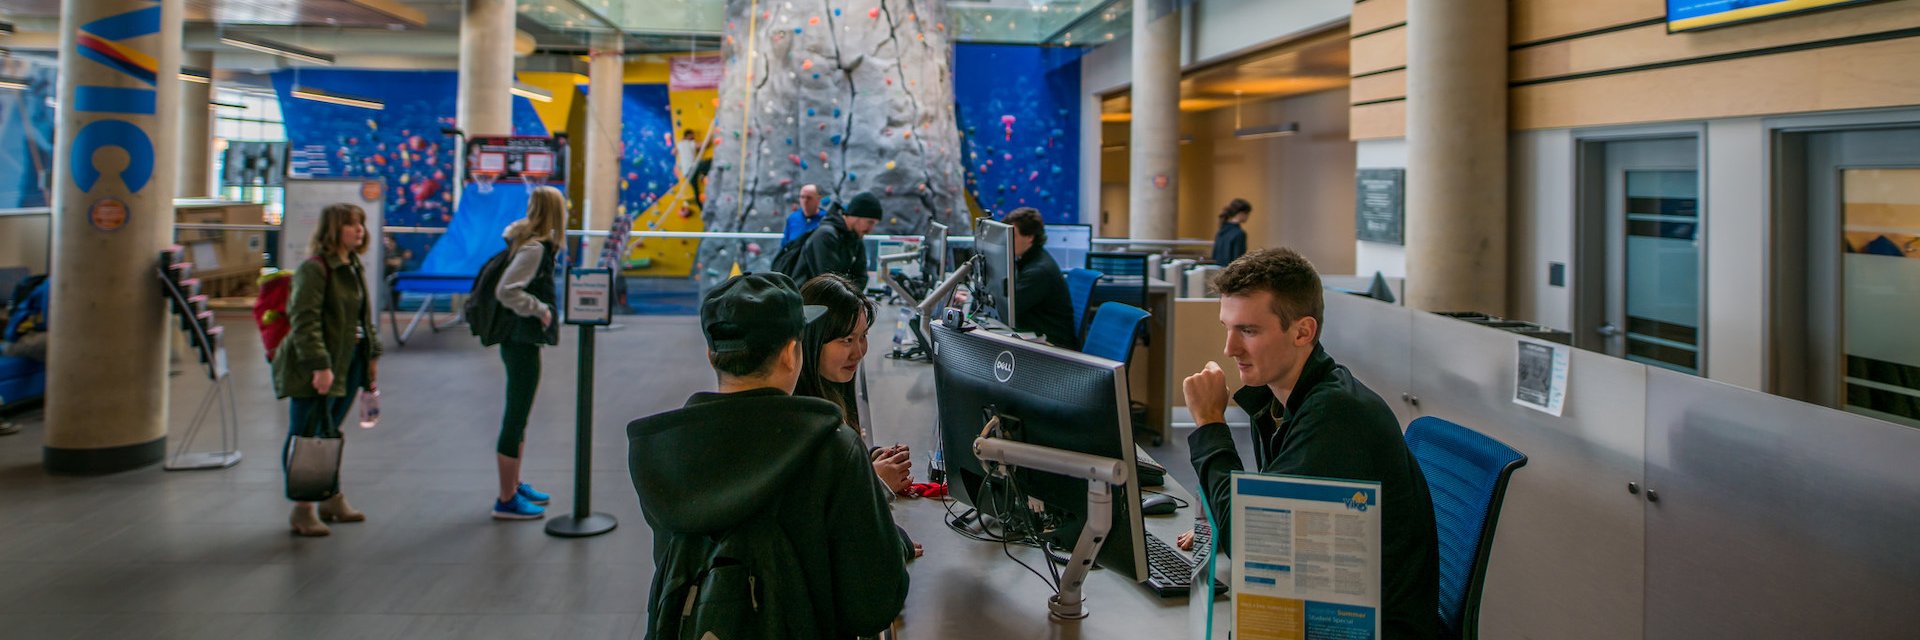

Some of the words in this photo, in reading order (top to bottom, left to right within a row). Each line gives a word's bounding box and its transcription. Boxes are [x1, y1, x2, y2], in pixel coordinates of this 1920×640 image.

[996, 360, 1012, 372] DELL
[1337, 609, 1367, 618] Summer
[1308, 614, 1332, 623] Student
[1333, 616, 1354, 624] Special
